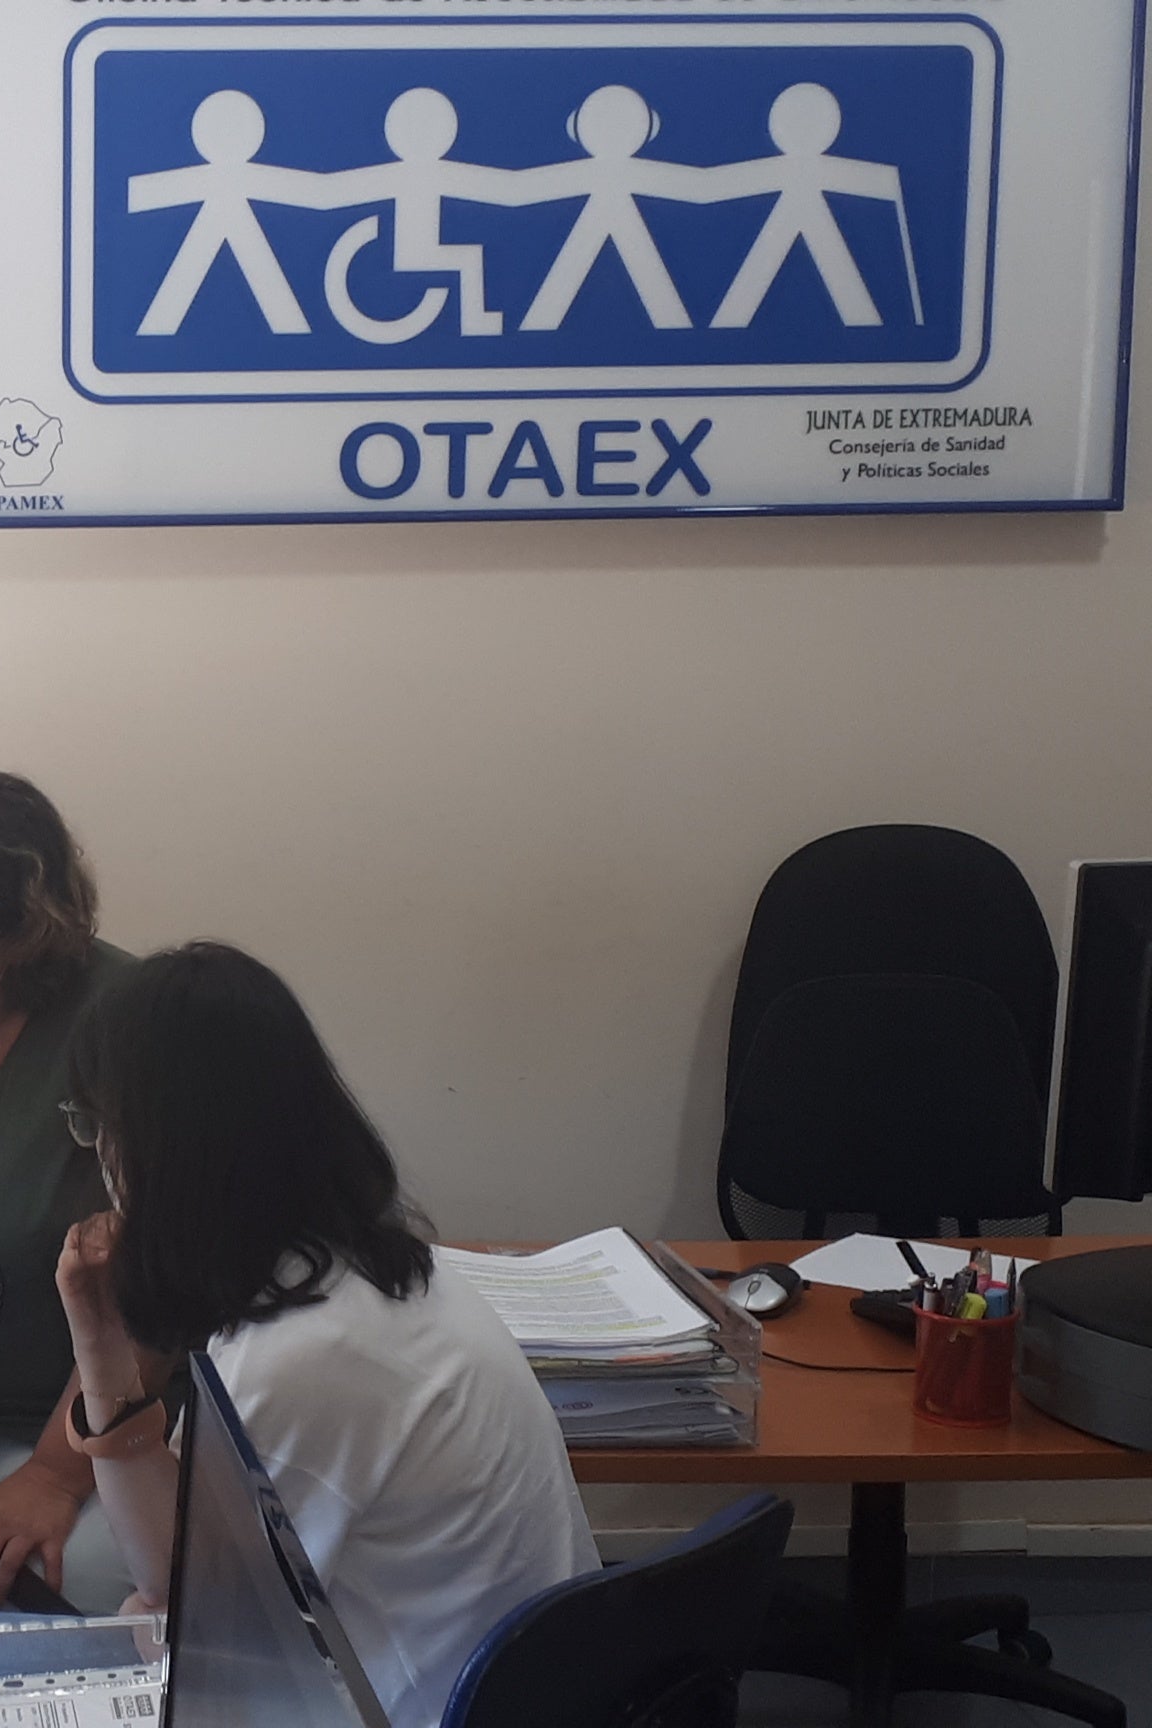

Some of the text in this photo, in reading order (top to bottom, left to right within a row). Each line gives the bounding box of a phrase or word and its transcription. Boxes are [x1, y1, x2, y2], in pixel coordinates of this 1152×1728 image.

[806, 407, 1033, 434] JUNTA DE EXTREMADURA
[829, 435, 1006, 456] Consejería de Sanidad
[340, 418, 712, 500] OTAEX
[841, 460, 990, 482] y Políticas Sociales
